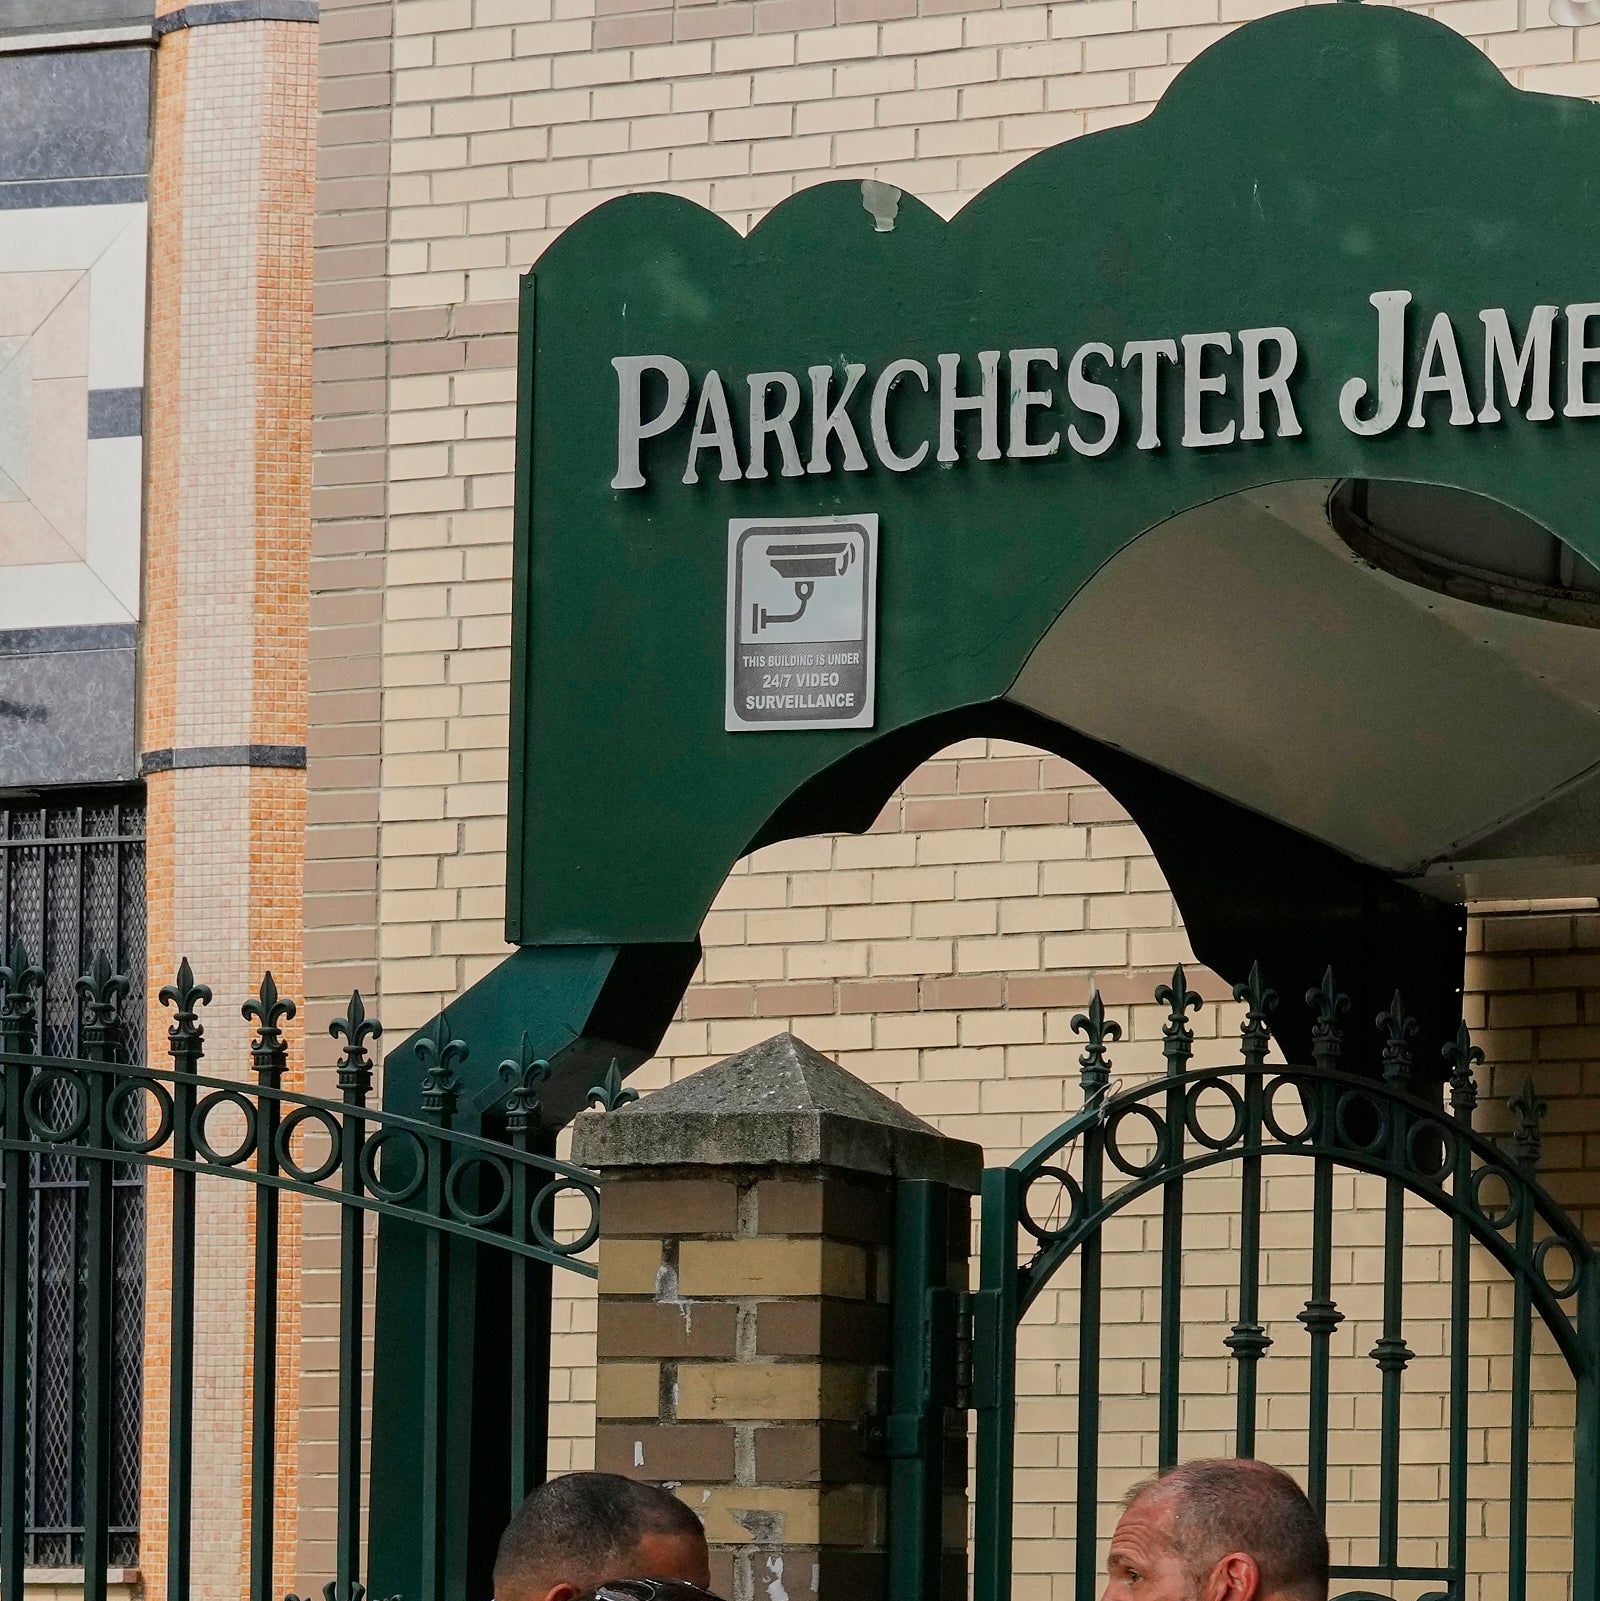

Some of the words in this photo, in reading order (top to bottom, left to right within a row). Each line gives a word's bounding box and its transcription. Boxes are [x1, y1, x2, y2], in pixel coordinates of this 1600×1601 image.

[611, 326, 1302, 489] PARKCHESTER
[742, 655, 766, 668] THIS
[768, 654, 814, 668] BUILDING
[816, 653, 826, 667] IS
[827, 652, 860, 666] UNDER
[762, 673, 792, 689] 24/7
[795, 672, 840, 688] VIDEO
[745, 692, 855, 711] SURVEILLANCE
